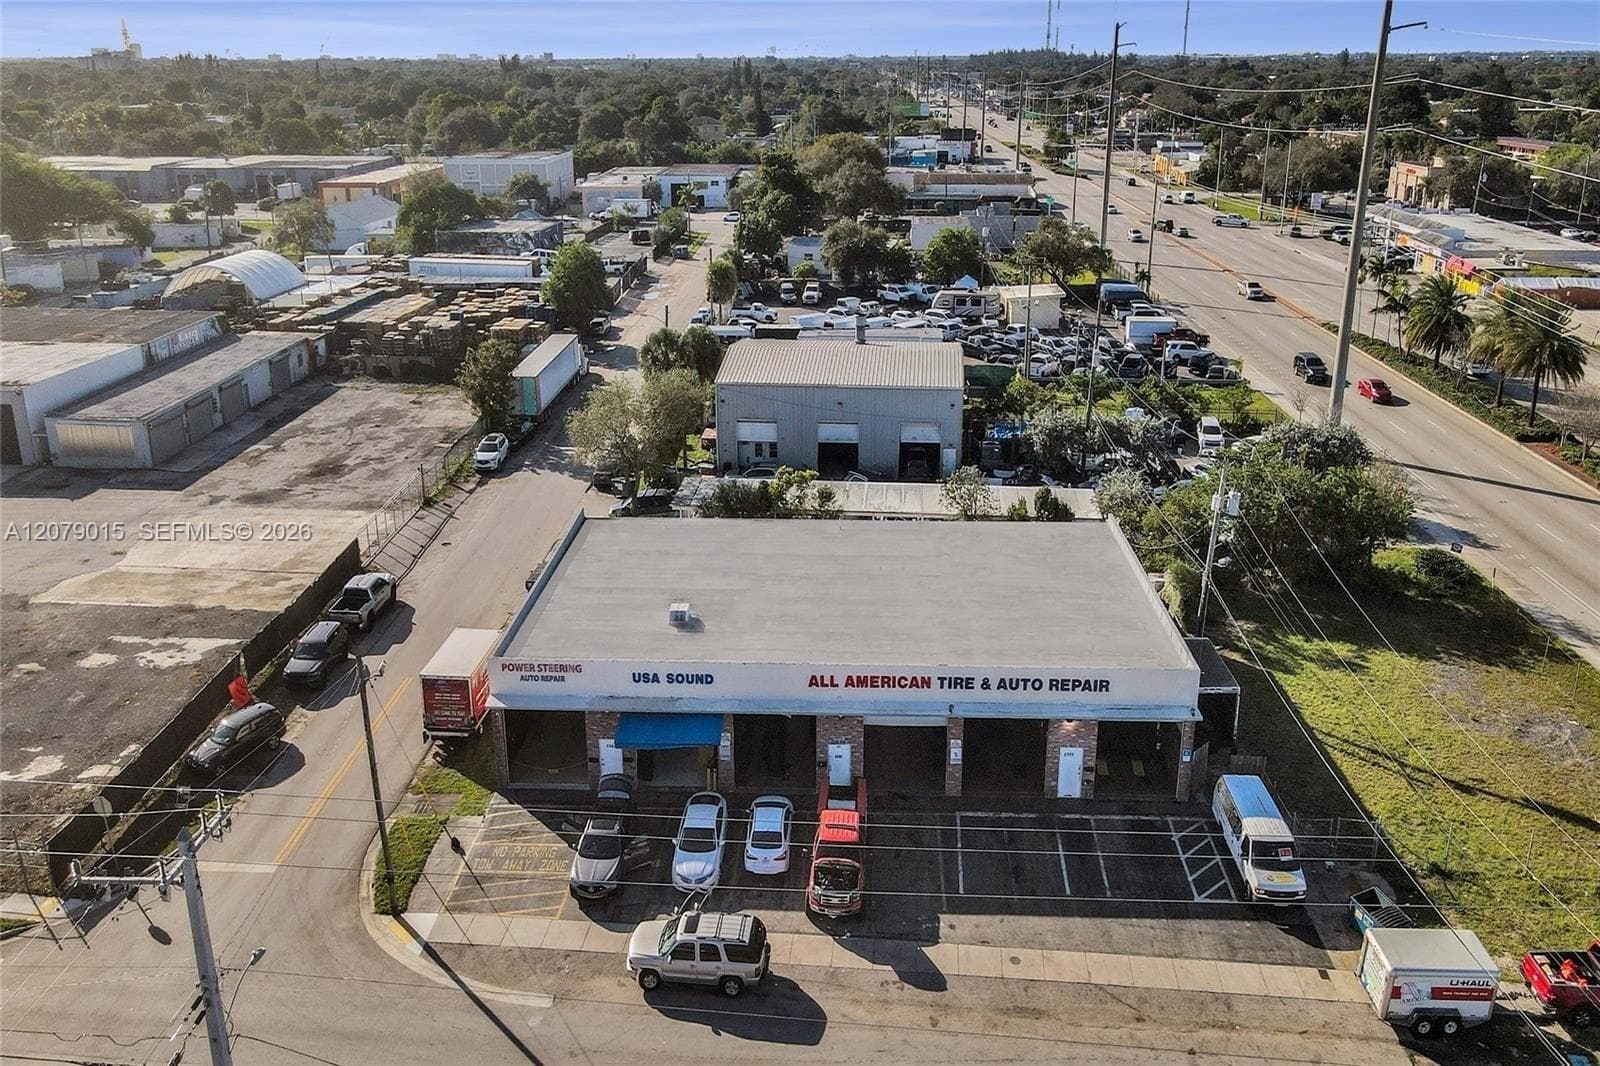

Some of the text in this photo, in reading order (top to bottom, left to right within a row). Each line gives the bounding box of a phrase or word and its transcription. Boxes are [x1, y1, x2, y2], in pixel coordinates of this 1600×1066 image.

[501, 663, 582, 674] POWER STEERING
[520, 674, 566, 683] AUTO REPAIR
[632, 672, 714, 685] USA SOUND
[808, 674, 1111, 693] ALL AMERICAN TIRE & AUTO REPAIR
[492, 846, 558, 858] NO PARKING
[473, 858, 569, 871] TOW AWAY ZONE
[1449, 979, 1492, 987] U-HAUL
